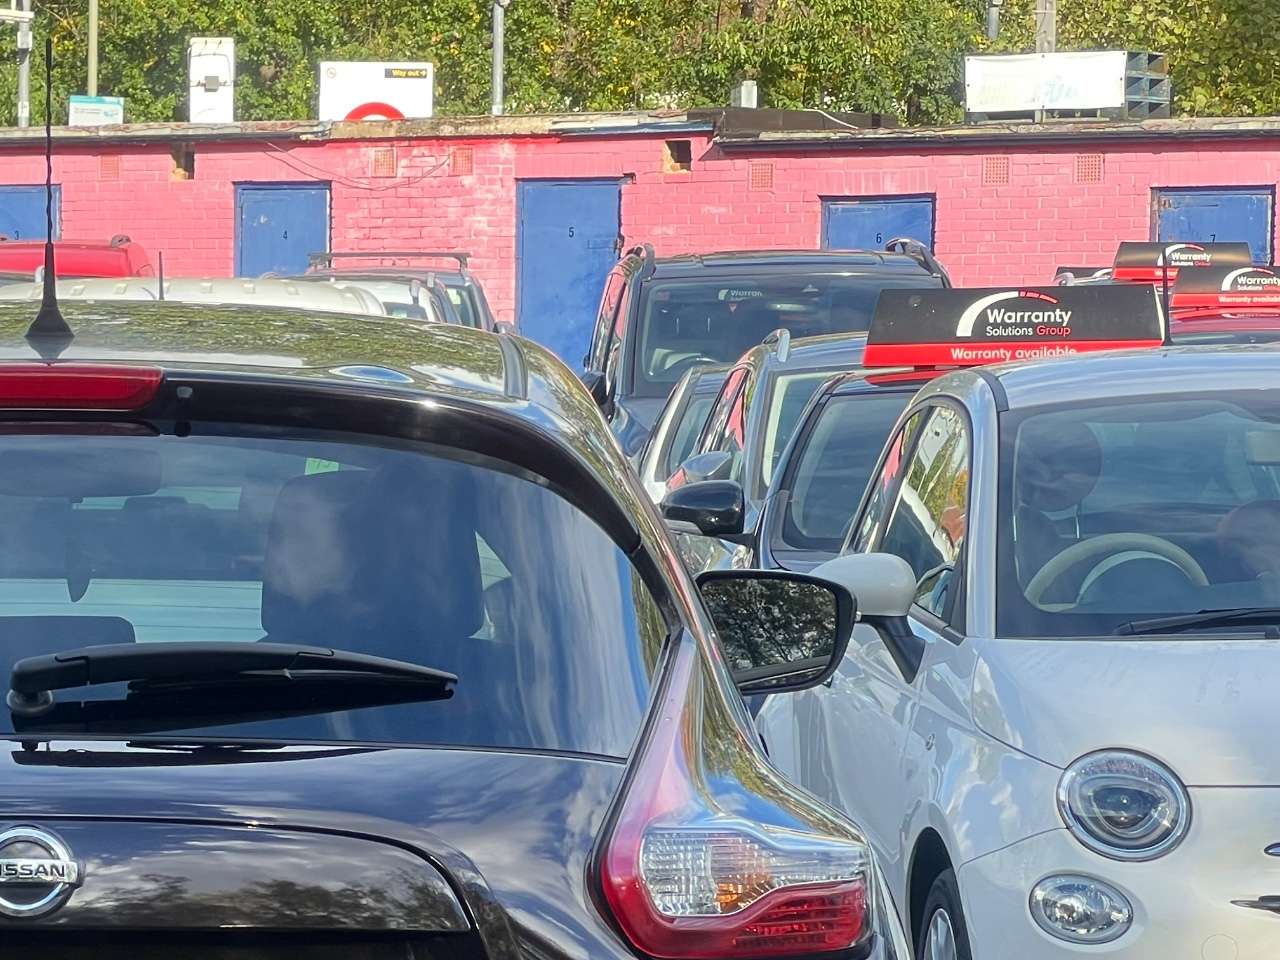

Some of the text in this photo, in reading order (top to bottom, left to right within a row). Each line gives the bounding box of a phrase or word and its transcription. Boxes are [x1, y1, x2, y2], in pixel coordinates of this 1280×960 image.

[568, 226, 575, 239] 5
[876, 232, 882, 244] 6
[1171, 252, 1212, 263] Warranty
[986, 308, 1072, 327] Warranty
[985, 325, 1071, 337] Solutions Group
[950, 348, 1012, 360] Warranty
